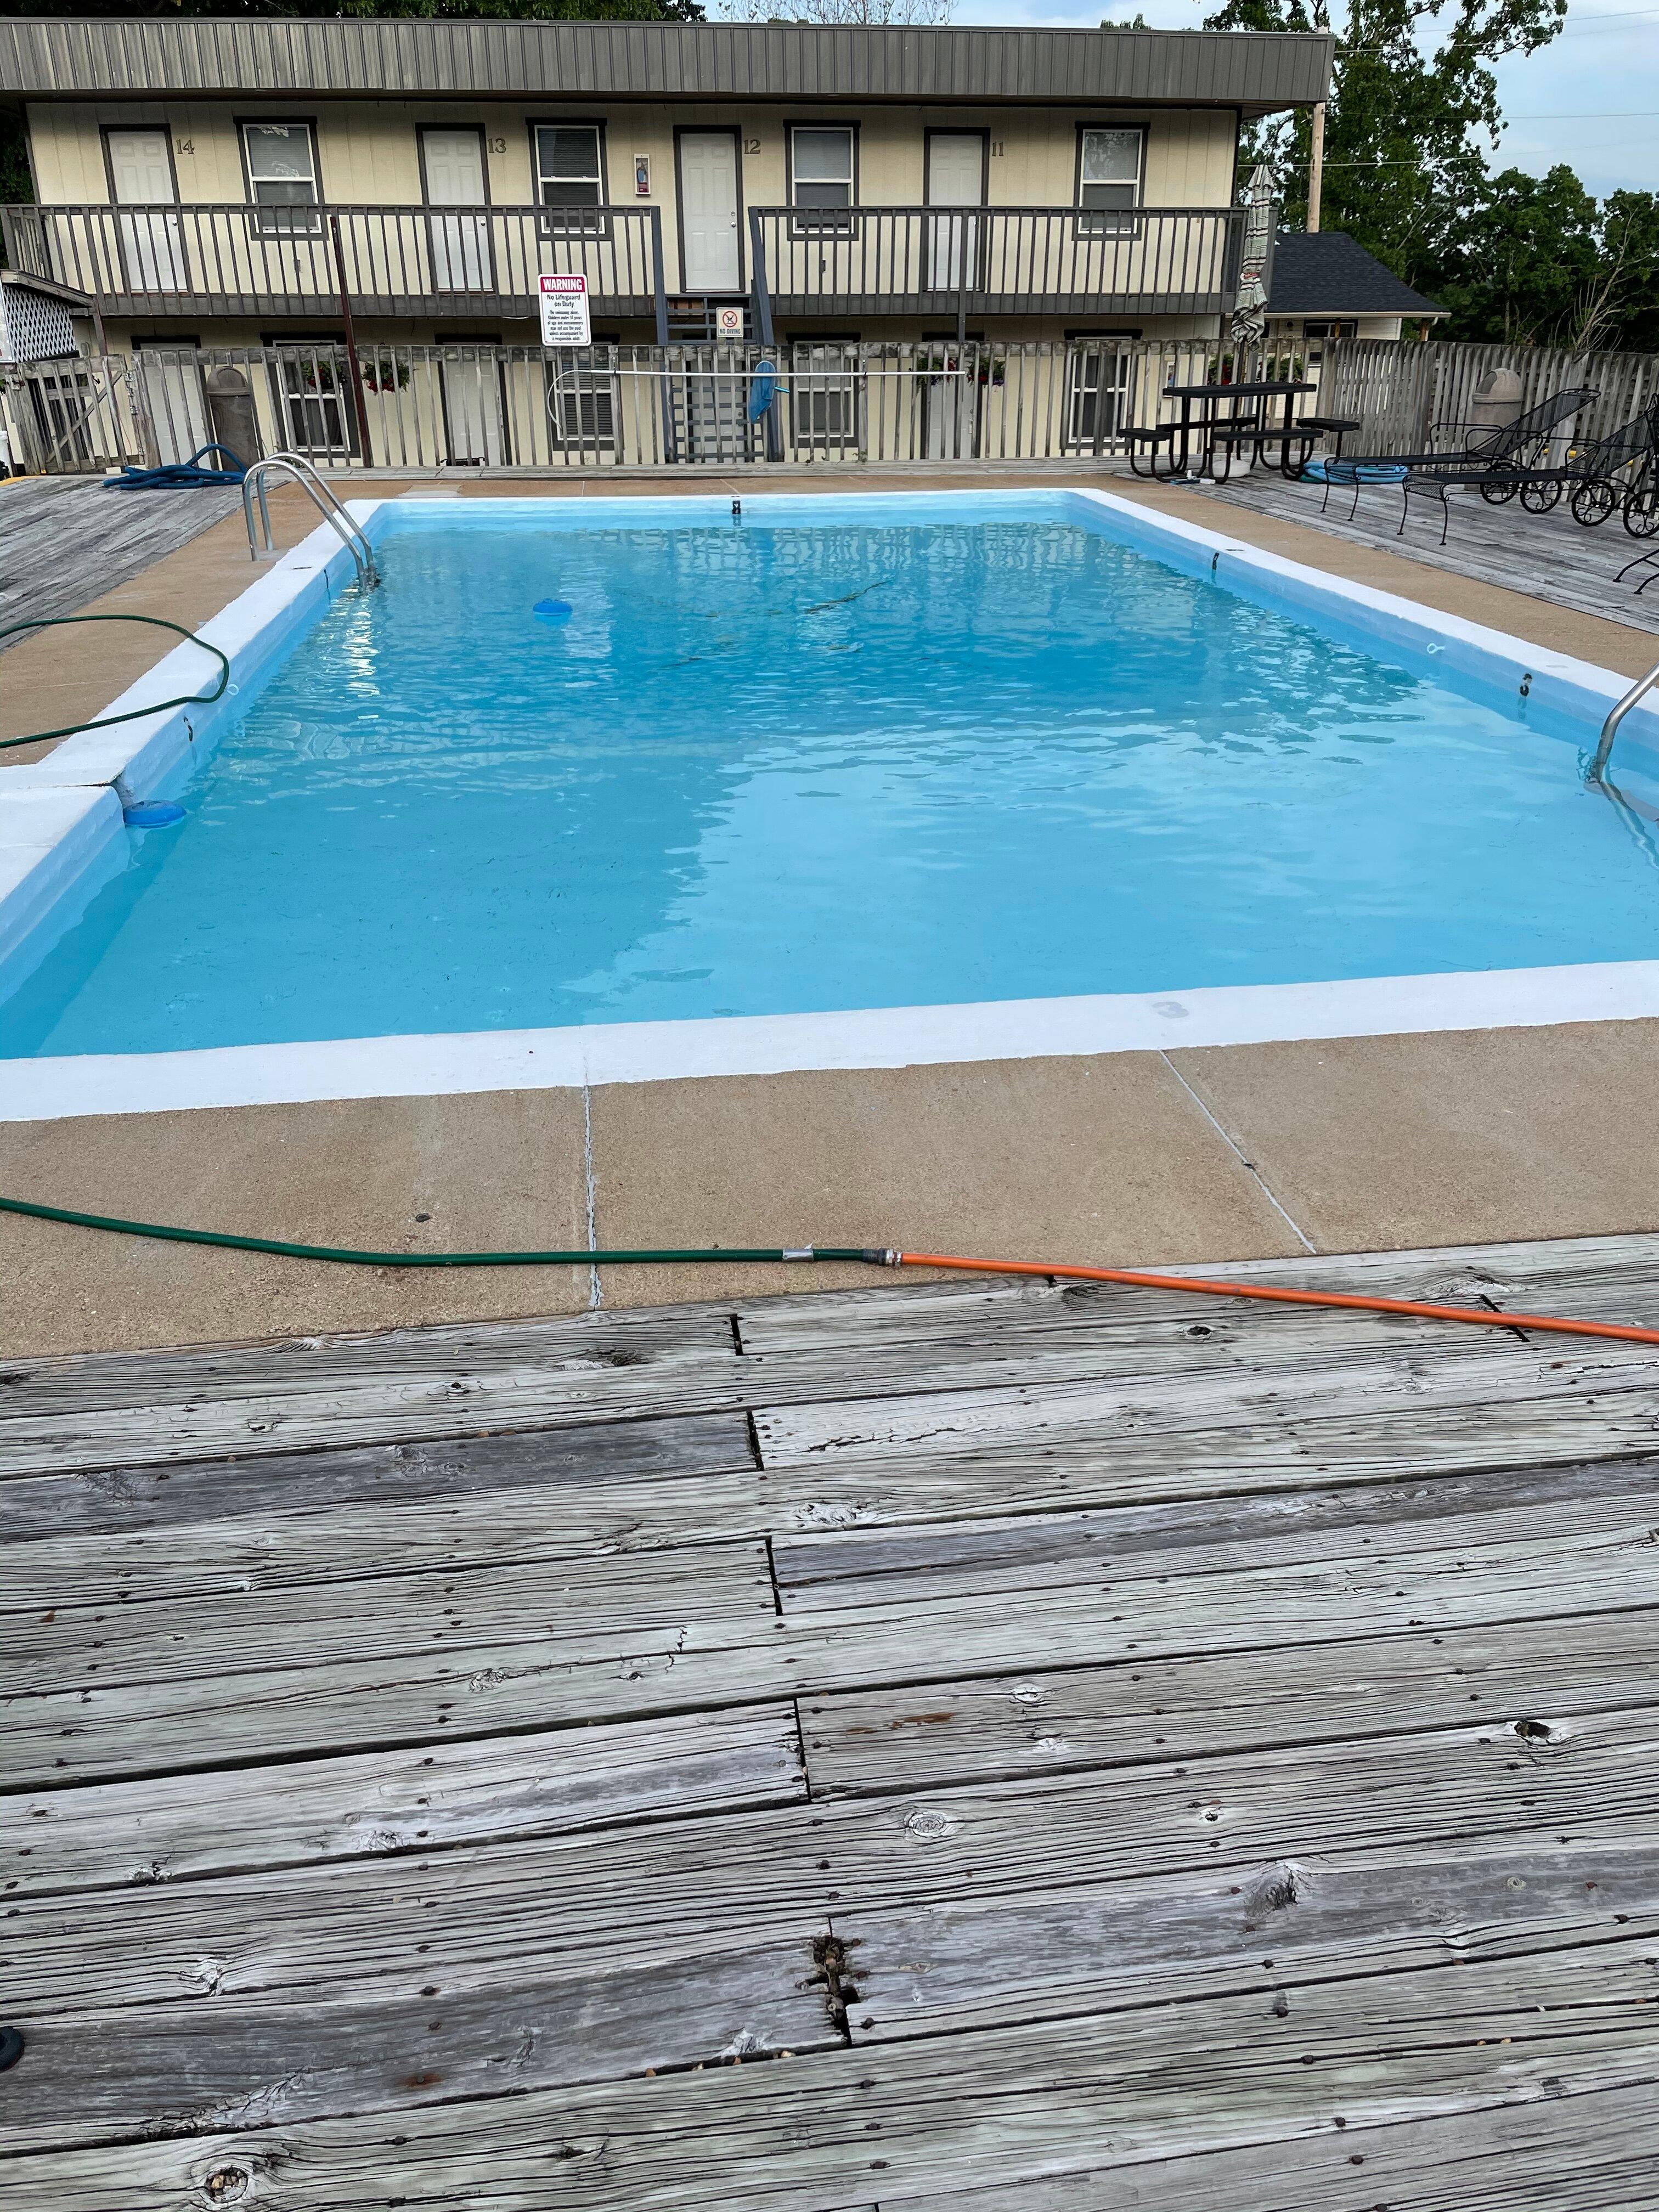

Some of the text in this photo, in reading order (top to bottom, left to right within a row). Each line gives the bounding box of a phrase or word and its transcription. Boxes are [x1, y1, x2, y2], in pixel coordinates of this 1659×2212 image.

[176, 139, 195, 155] 14
[488, 138, 506, 154] 13
[744, 139, 761, 154] 12
[991, 142, 1004, 157] 11
[543, 278, 583, 291] WARNING
